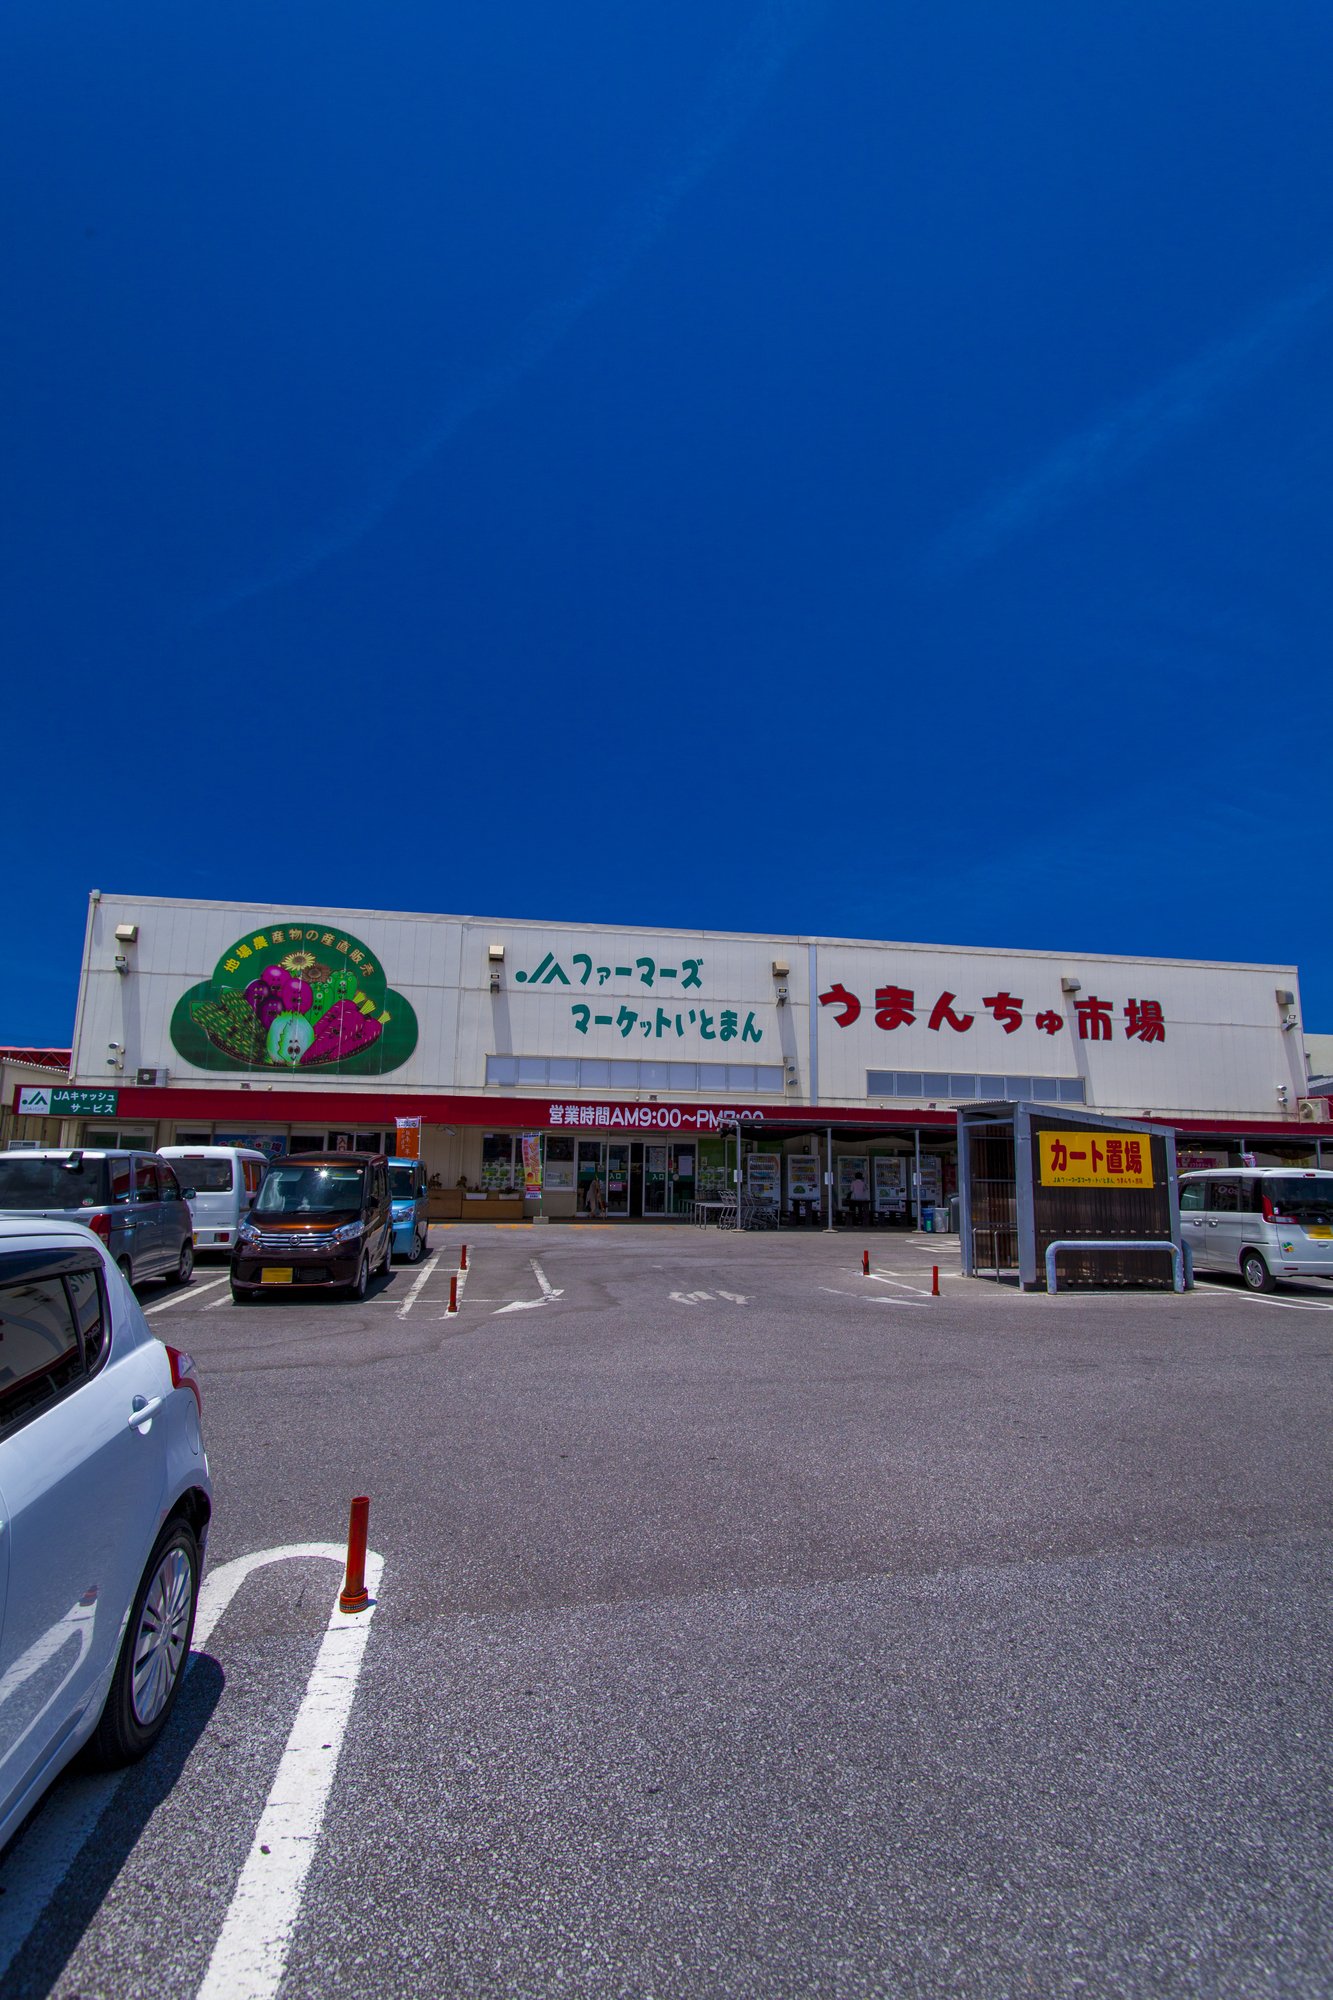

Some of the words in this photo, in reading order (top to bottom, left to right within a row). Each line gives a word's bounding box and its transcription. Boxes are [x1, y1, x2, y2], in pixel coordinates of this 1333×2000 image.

[223, 928, 376, 977] 地場農産物の産直販売
[571, 1003, 763, 1043] マーケットいとまん
[818, 983, 1166, 1044] うまんちゅ市場
[53, 1091, 116, 1102] JAキャッシュ
[70, 1103, 114, 1113] サービス
[1050, 1138, 1143, 1175] カート置場
